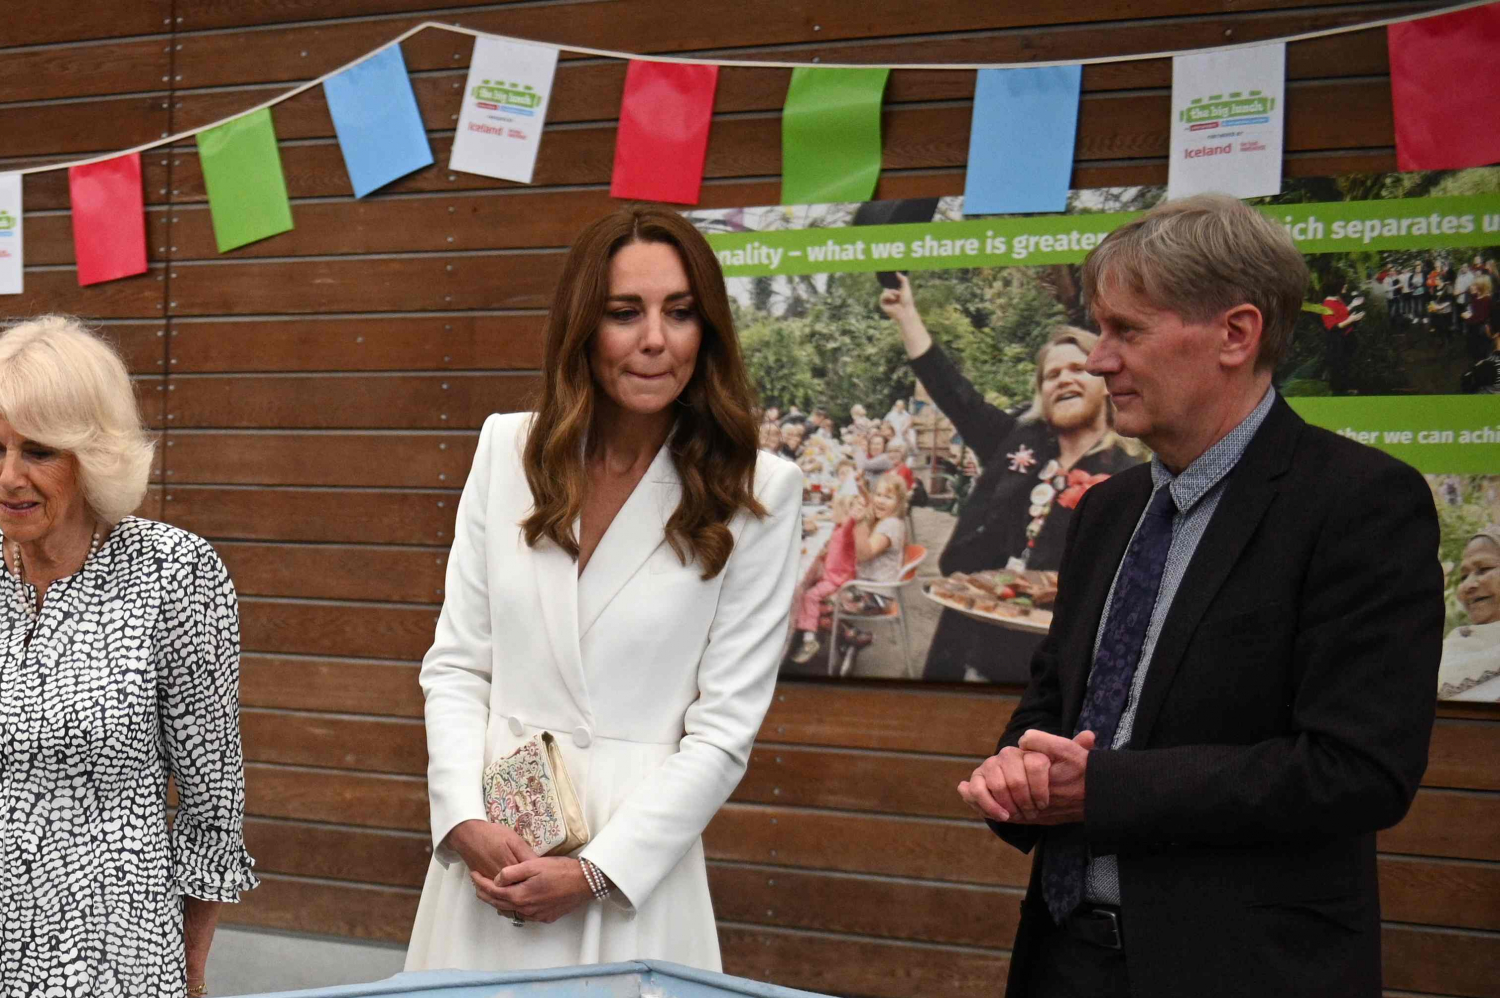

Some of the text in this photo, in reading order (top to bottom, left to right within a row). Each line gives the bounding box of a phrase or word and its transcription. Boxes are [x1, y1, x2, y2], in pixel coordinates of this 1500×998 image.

[1190, 100, 1264, 119] the big lunch
[1184, 143, 1232, 159] Iceland
[1283, 214, 1324, 240] ich
[1331, 212, 1475, 244] separates
[716, 241, 784, 270] nality
[807, 240, 865, 262] what
[871, 241, 905, 259] we
[911, 234, 979, 258] share
[985, 230, 1007, 254] is
[1383, 430, 1413, 443] we
[1417, 430, 1453, 443] can
